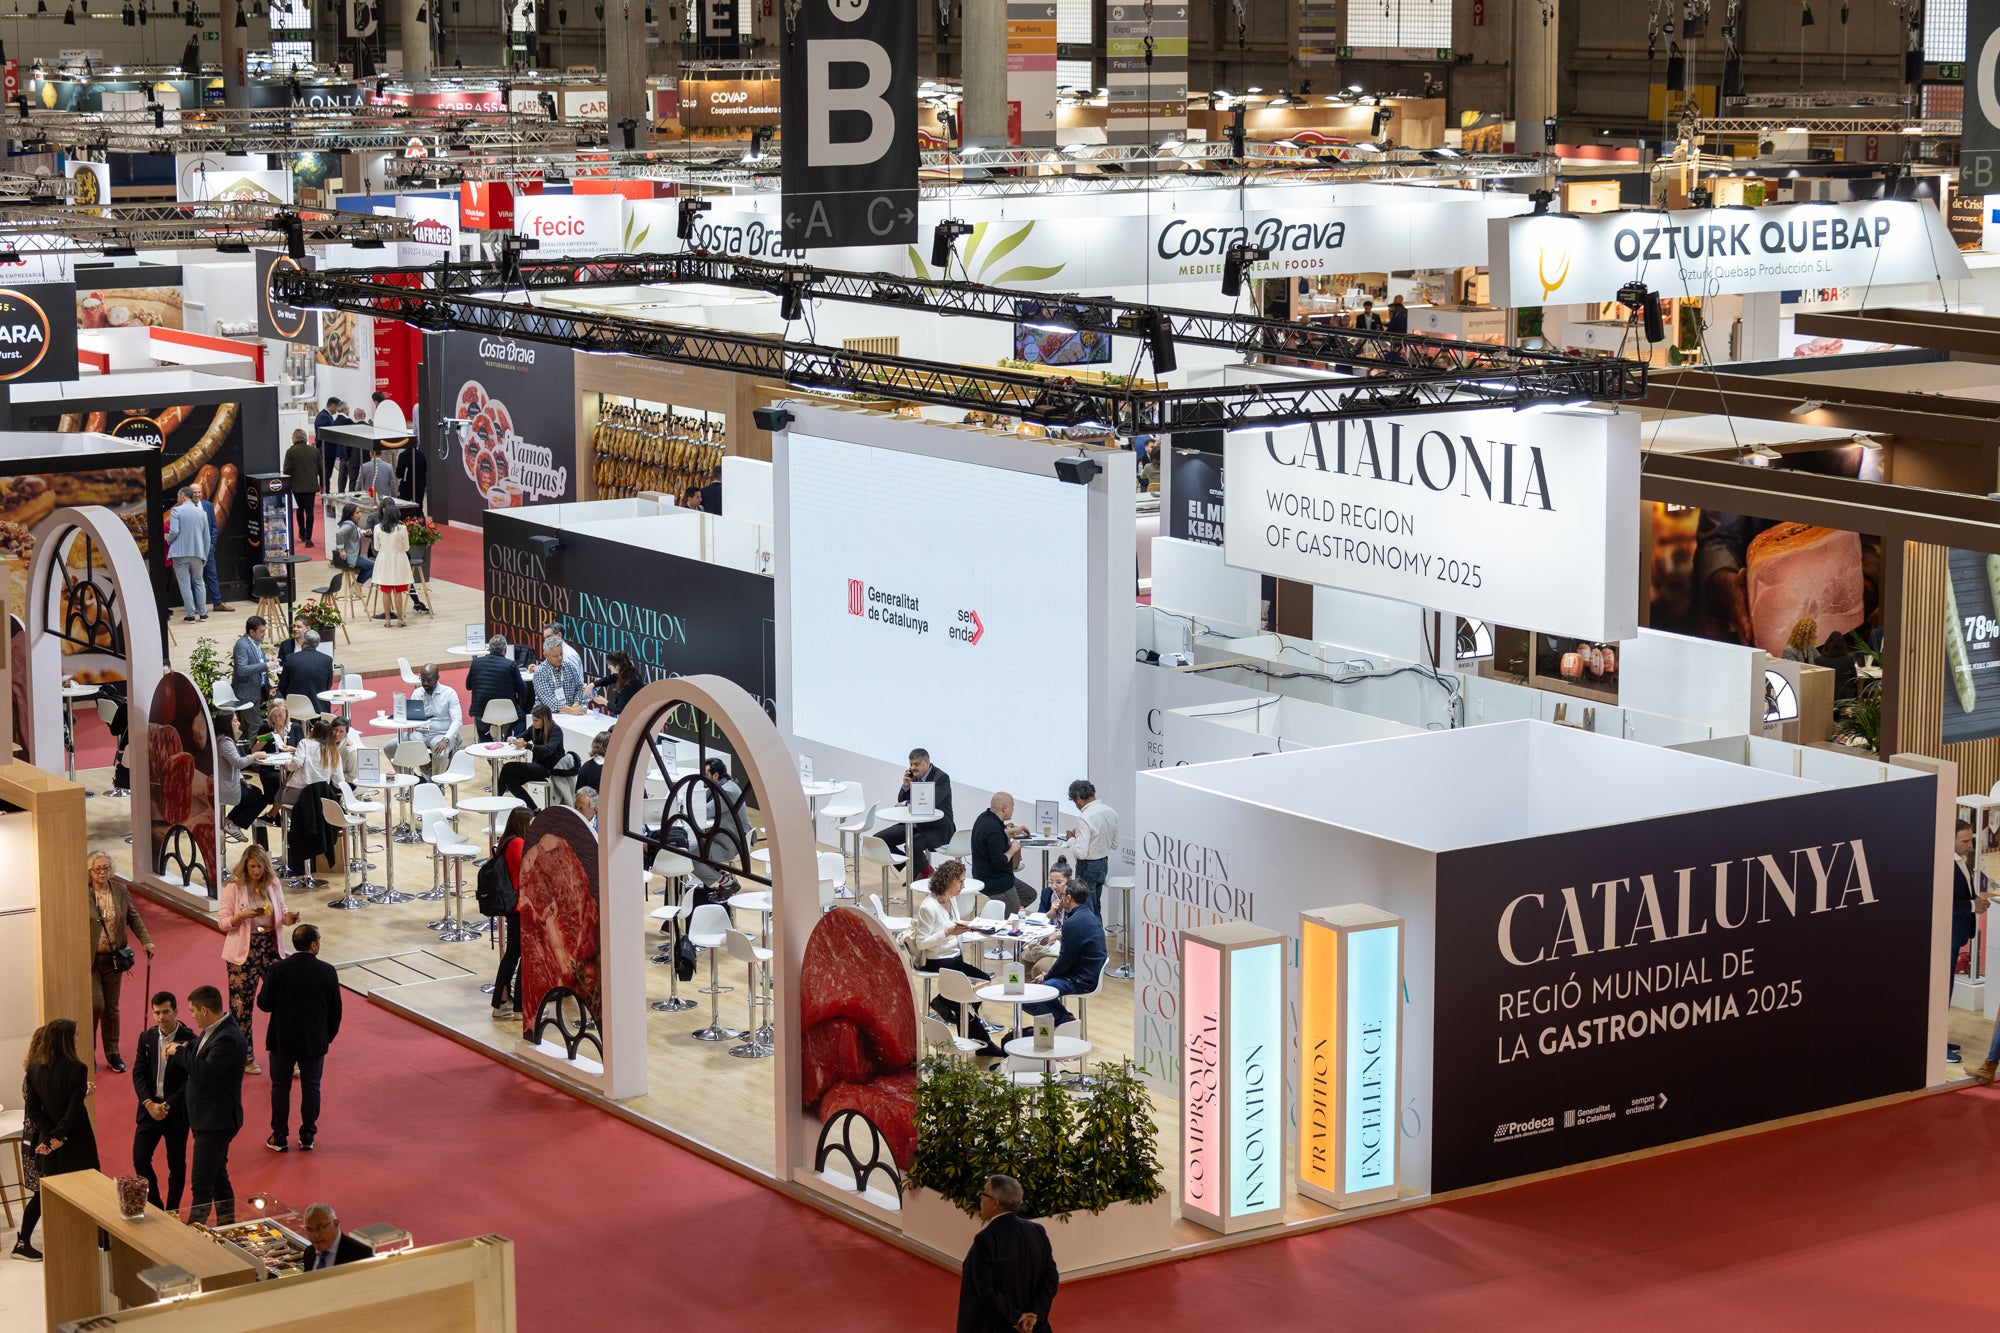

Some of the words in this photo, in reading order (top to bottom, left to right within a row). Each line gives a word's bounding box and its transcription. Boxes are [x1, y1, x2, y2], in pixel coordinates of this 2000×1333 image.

[705, 0, 732, 37] E
[1016, 25, 1042, 33] Pavilions
[1113, 42, 1138, 52] Organic
[1113, 61, 1127, 69] Fine
[579, 101, 607, 115] CAR
[681, 99, 698, 108] COAP
[710, 91, 748, 104] COVAP
[710, 106, 748, 116] Cooperativa
[748, 105, 778, 114] Ganadera
[807, 39, 896, 167] B
[1975, 155, 1994, 188] B
[497, 210, 514, 218] Viña
[533, 215, 586, 237] fecic
[804, 200, 833, 239] A
[867, 196, 895, 237] C
[1157, 218, 1249, 260] Costa
[1254, 217, 1346, 253] Brava
[1613, 222, 1752, 263] OZTURK
[1759, 215, 1891, 254] QUEBAP
[1284, 258, 1325, 270] FOODS
[1678, 264, 1714, 281] Ozturk
[1714, 263, 1757, 280] Quebap
[1758, 260, 1815, 276] Producción
[1815, 259, 1834, 273] S.L.
[0, 323, 44, 344] ARA
[0, 350, 23, 359] urst.
[479, 337, 506, 360] Costa
[506, 342, 536, 365] Brava
[510, 462, 520, 478] de
[1265, 419, 1556, 511] CATALONIA
[1188, 499, 1205, 520] EL
[1266, 489, 1335, 522] WORLD
[1341, 502, 1415, 536] REGION
[1188, 519, 1224, 542] KEBA
[488, 543, 546, 581] ORIGIN
[1266, 525, 1291, 548] OF
[1296, 530, 1432, 577] GASTRONOMY
[1437, 556, 1482, 589] 2025
[488, 568, 574, 614] TERRITORY
[579, 592, 687, 646] INNOVATION
[867, 585, 920, 612] Generalitat
[868, 605, 880, 621] de
[882, 608, 929, 635] Catalunya
[1964, 614, 1999, 642] 78%
[562, 614, 665, 668] EXCELLENCE
[1142, 830, 1230, 882] ORIGEN
[1142, 859, 1255, 923] TERRITORI
[1497, 838, 1880, 966] CATALUNYA
[1141, 921, 1181, 961] TRA
[1498, 971, 1582, 1022] REGIÓ
[1592, 956, 1712, 1005] MUNDIAL
[1722, 948, 1755, 980] DE
[1143, 1013, 1179, 1054] INT
[1498, 1033, 1530, 1065] LA
[1538, 993, 1740, 1056] GASTRONOMIA
[1746, 979, 1803, 1017] 2025
[1203, 1011, 1219, 1107] SOCIAL
[1311, 1037, 1328, 1175] TRADITION
[1362, 1019, 1382, 1180] EXCELLENCE
[1577, 1103, 1611, 1117] Generalitat
[1625, 1102, 1655, 1116] endavant
[1631, 1094, 1655, 1107] sempre
[1245, 1043, 1265, 1208] INNOVATION
[1509, 1115, 1555, 1134] Prodeca
[1577, 1118, 1585, 1126] de
[1586, 1111, 1616, 1124] Catalunya
